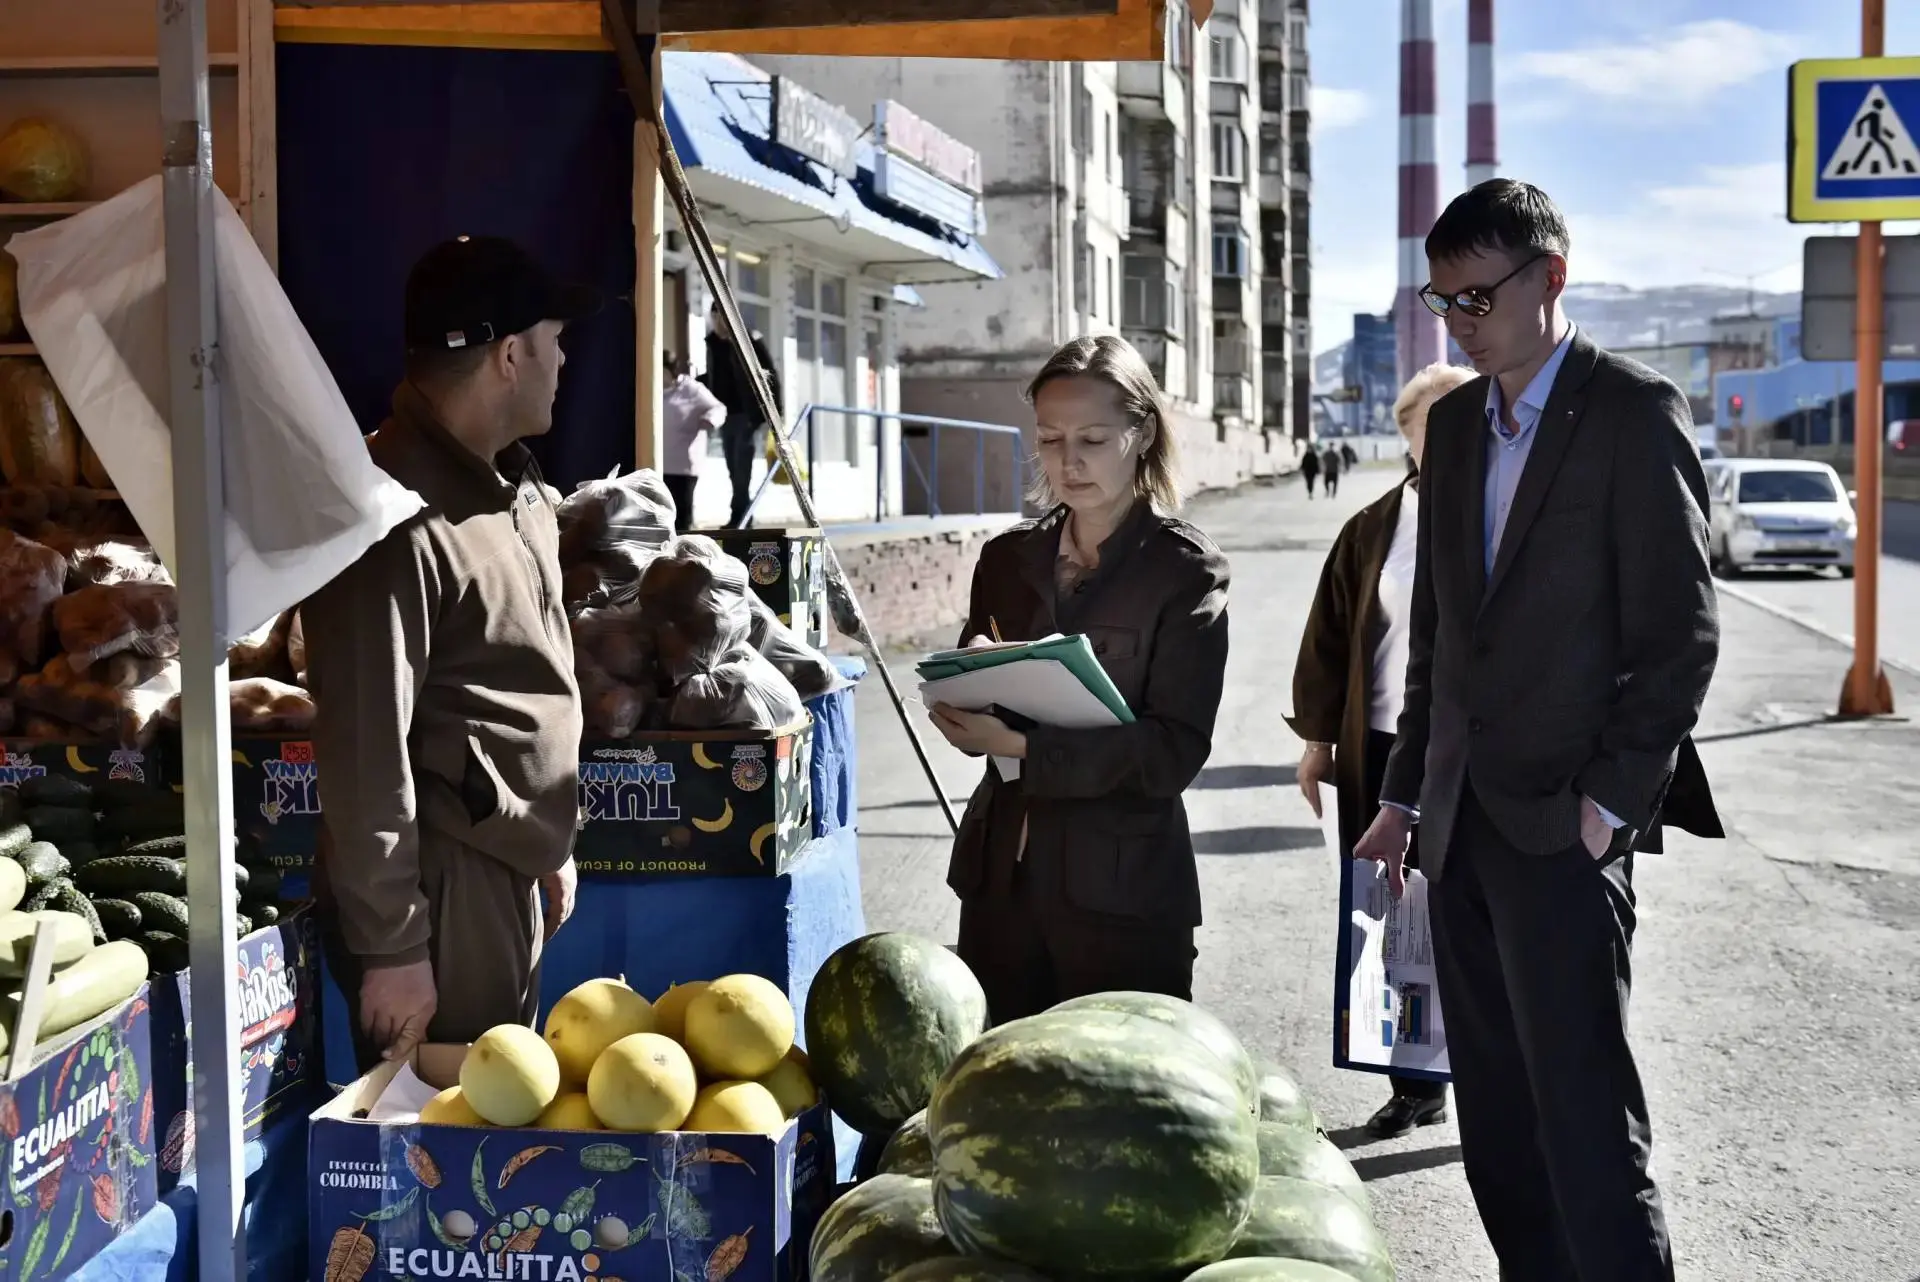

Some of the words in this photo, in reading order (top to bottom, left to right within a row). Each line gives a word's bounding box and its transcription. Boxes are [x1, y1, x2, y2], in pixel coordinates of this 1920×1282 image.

[266, 855, 302, 866] ECU
[617, 861, 634, 871] OF
[639, 861, 706, 871] PRODUCT
[239, 965, 297, 1032] laRosa
[12, 1081, 110, 1173] ECUALITTA
[328, 1160, 374, 1172] PRODUCT
[320, 1172, 399, 1190] COLOMBIA
[389, 1247, 581, 1282] ECUALITTA
